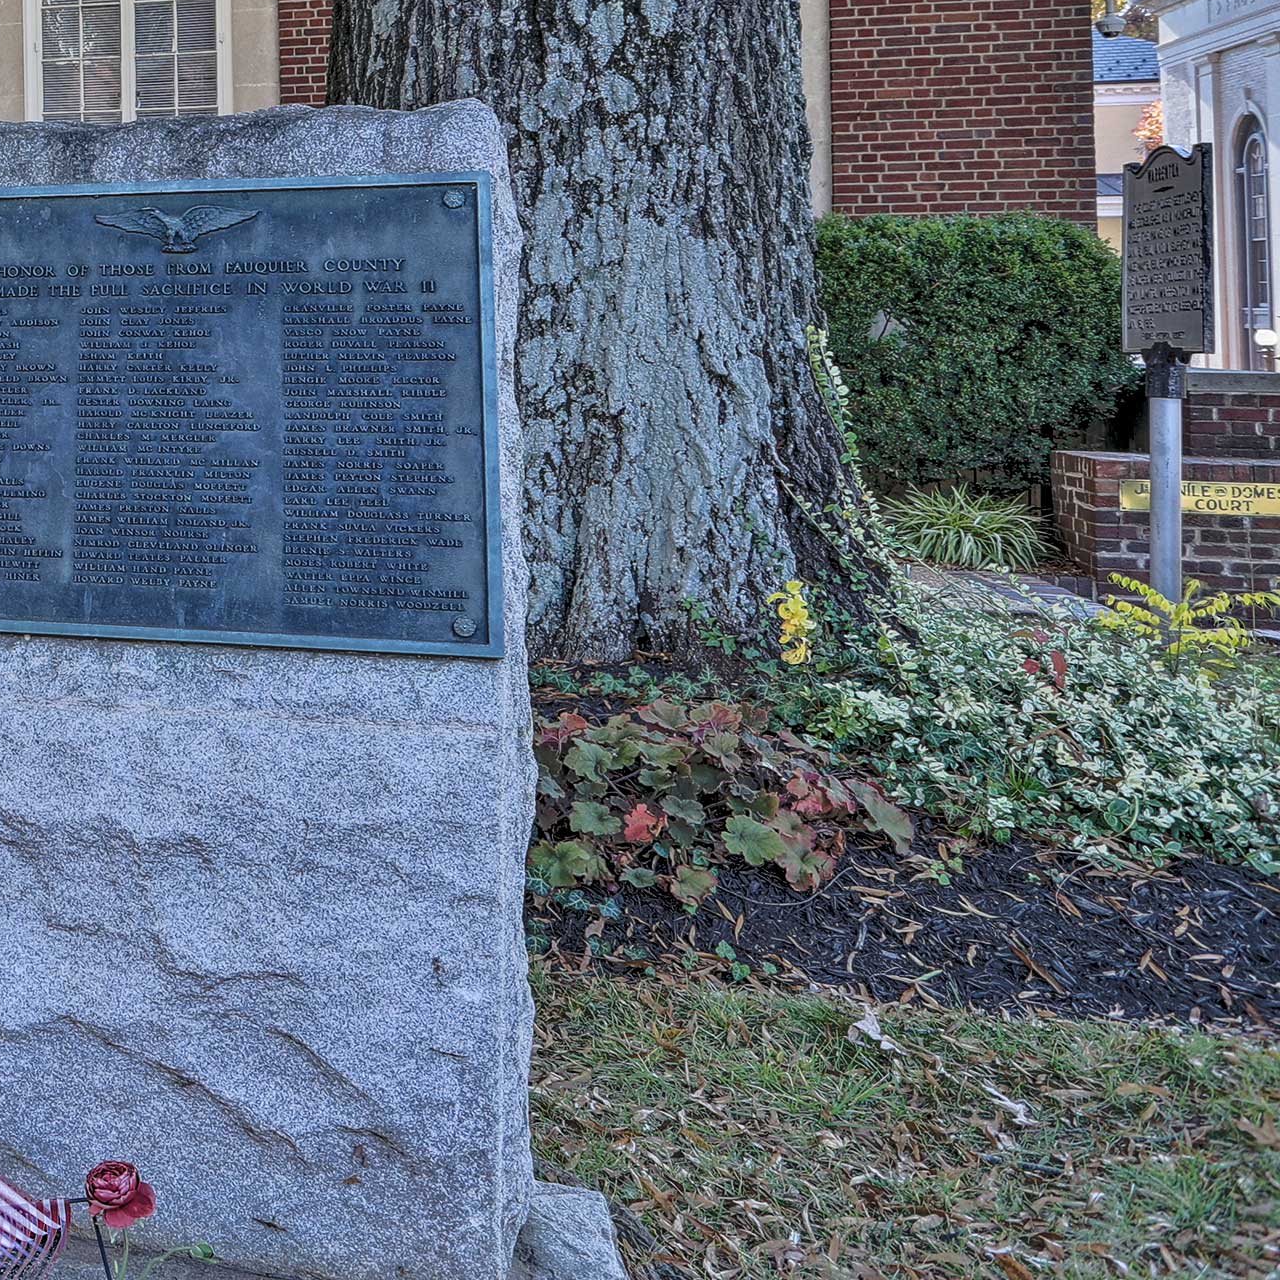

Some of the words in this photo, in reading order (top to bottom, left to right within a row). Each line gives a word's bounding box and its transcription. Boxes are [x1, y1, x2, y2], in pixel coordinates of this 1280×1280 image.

[67, 264, 89, 277] OF
[100, 264, 154, 276] THOSE
[167, 262, 212, 275] FROM
[226, 260, 308, 274] FAUQUIER
[324, 259, 406, 272] COUNTY
[48, 286, 81, 298] THE
[90, 284, 128, 297] FULL
[142, 282, 232, 296] SACRIFICE
[247, 282, 267, 294] IN
[281, 281, 352, 294] WORLD
[365, 280, 407, 294] WAR
[421, 279, 436, 293] II
[284, 304, 353, 313] GRANVILLE
[366, 304, 412, 312] FOSTER
[422, 304, 464, 312] PAYNE
[80, 318, 110, 326] JOHN
[121, 318, 150, 326] CLAY
[159, 317, 195, 325] JONES
[80, 330, 110, 338] JOHN
[118, 329, 165, 337] CONWAY
[284, 328, 322, 336] VASCO
[333, 328, 367, 336] SNOW
[378, 328, 421, 336] PAYNE
[0, 342, 20, 350] ASH
[331, 340, 378, 348] DUVALL
[388, 340, 445, 348] PEARSON
[284, 353, 329, 361] LUTHER
[338, 353, 385, 361] MELVIN
[397, 353, 456, 361] PEARSON
[79, 364, 118, 372] HARRY
[126, 364, 172, 372] CARTER
[180, 364, 218, 372] KELLY
[79, 387, 120, 395] FRANK
[128, 387, 139, 395] D.
[144, 387, 207, 395] LACKLAND
[327, 389, 393, 397] MARSHALL
[12, 443, 51, 451] DOWNS
[284, 449, 337, 457] RUSSELL
[367, 449, 406, 458] SMITH
[1135, 482, 1211, 497] JNILE
[1195, 499, 1254, 512] COURT
[284, 510, 339, 518] WILLIAM
[347, 511, 409, 520] DOUGLASS
[417, 513, 472, 522] TURNER
[74, 539, 120, 548] NIMROD
[127, 541, 198, 550] CLEVELAND
[73, 563, 126, 572] WILLIAM
[132, 565, 167, 574] HAND
[174, 567, 212, 576] PAYNE
[285, 560, 322, 568] MOSES
[330, 561, 377, 569] ROBERT
[386, 562, 429, 571] WHITE
[73, 575, 123, 584] HOWARD
[178, 579, 217, 589] PAYNE
